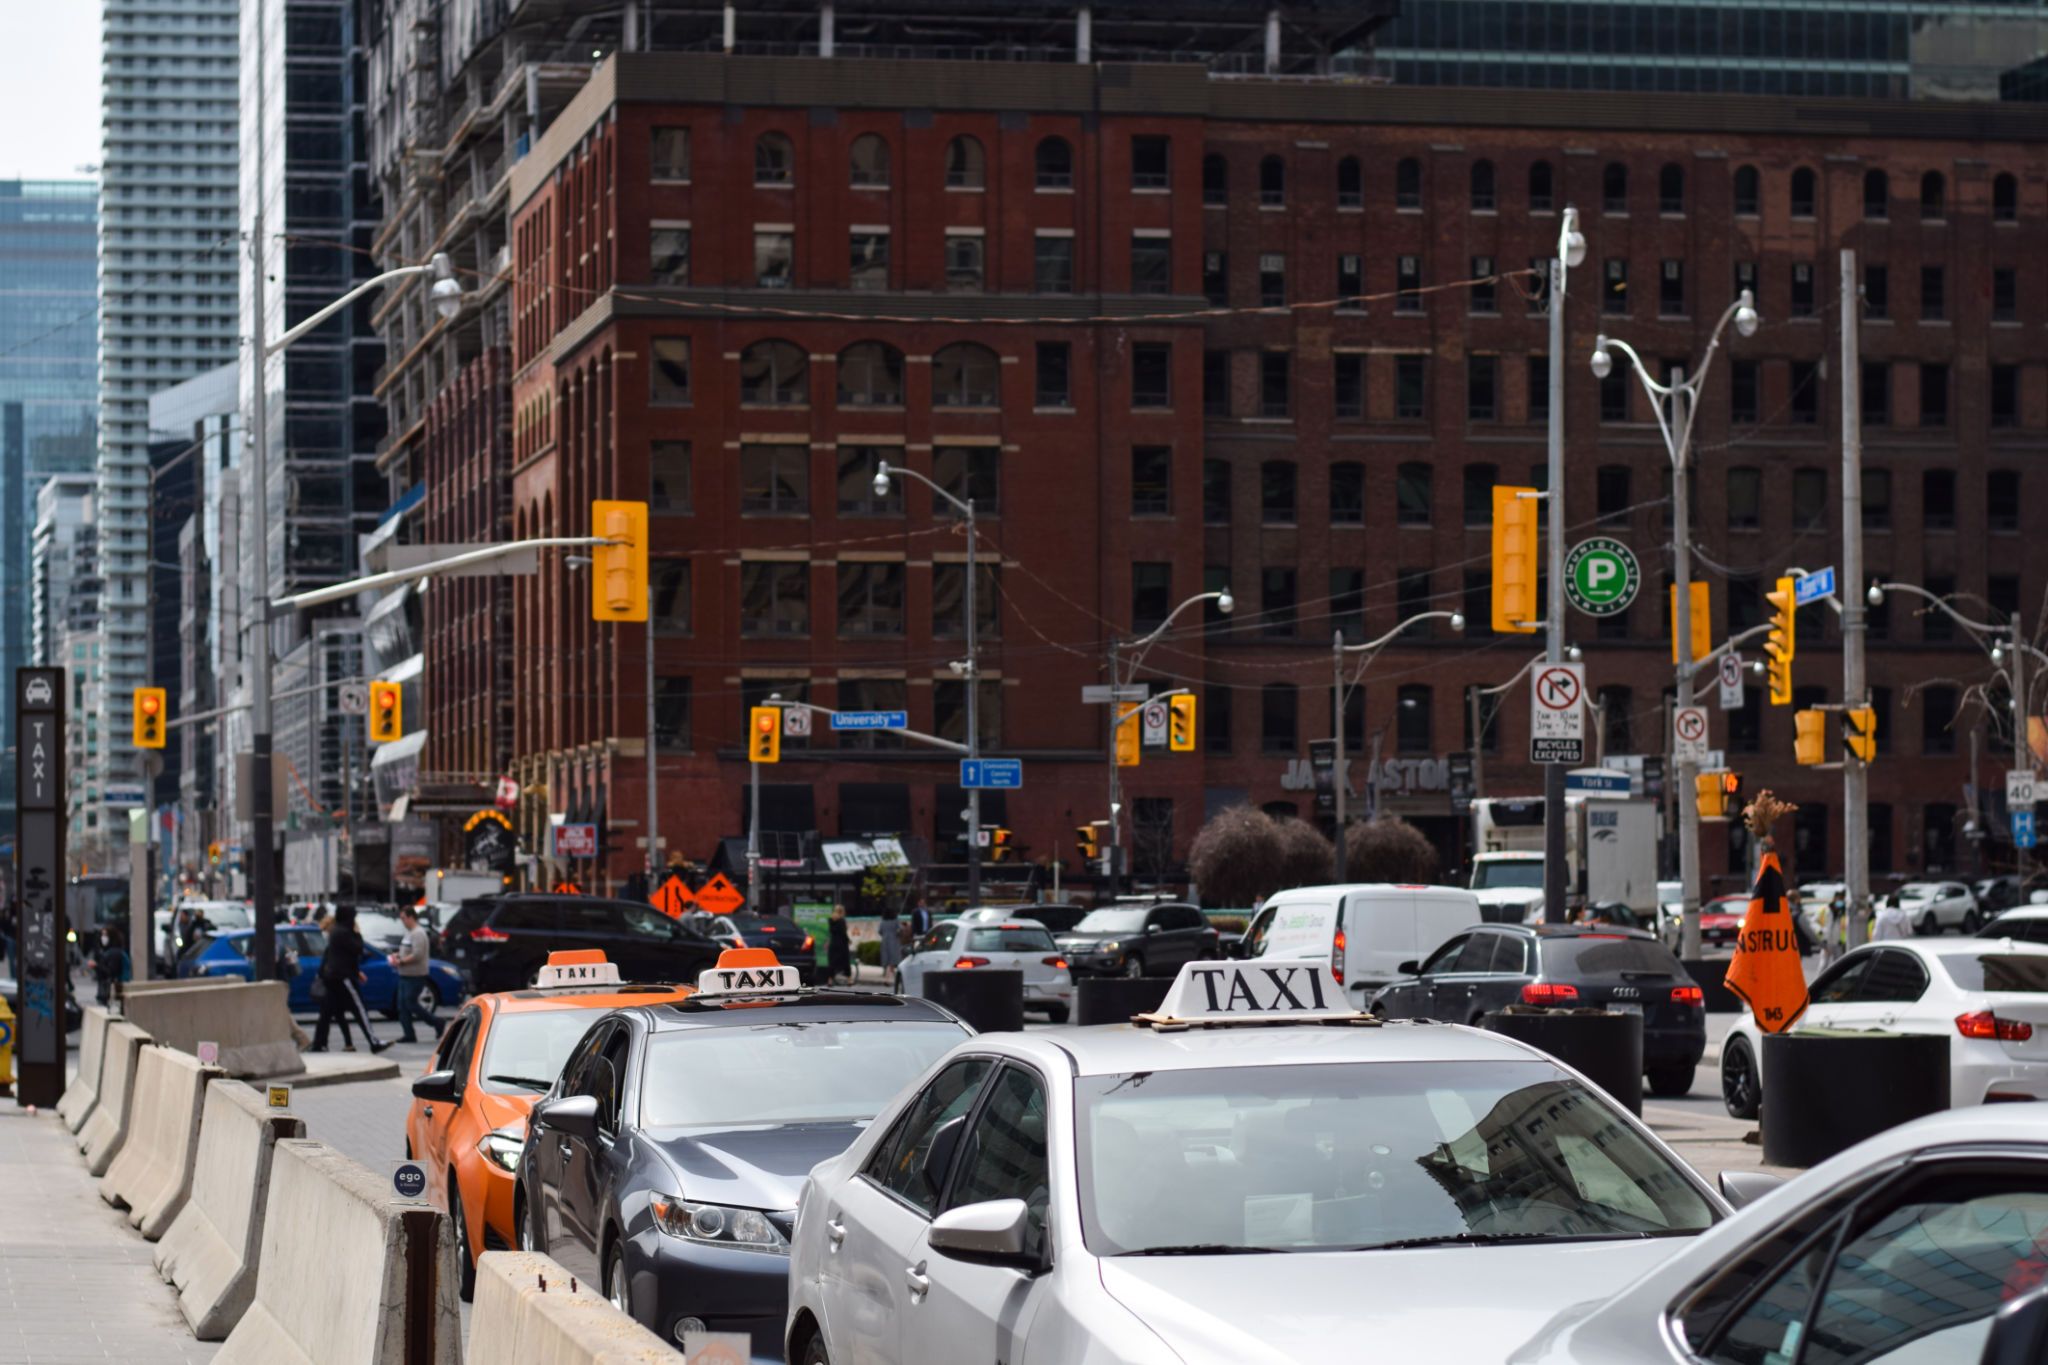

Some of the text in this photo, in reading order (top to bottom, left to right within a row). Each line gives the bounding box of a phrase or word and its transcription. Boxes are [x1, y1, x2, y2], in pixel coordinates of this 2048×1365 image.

[1567, 541, 1635, 574] MUNICIPAL
[1588, 558, 1617, 589] P
[1568, 583, 1635, 613] PARKING
[836, 713, 890, 728] University
[1535, 750, 1580, 760] EXCEPTED
[1536, 740, 1578, 750] BICYCLES
[31, 721, 46, 799] TAXI
[1280, 758, 1354, 793] JAK
[1582, 776, 1603, 788] York
[2010, 784, 2033, 800] 40
[2014, 813, 2033, 832] H
[830, 848, 902, 869] Pilsner
[555, 966, 596, 979] TAXI
[717, 969, 785, 990] TAXI
[1191, 967, 1329, 1012] TAXI
[399, 1173, 421, 1183] ego
